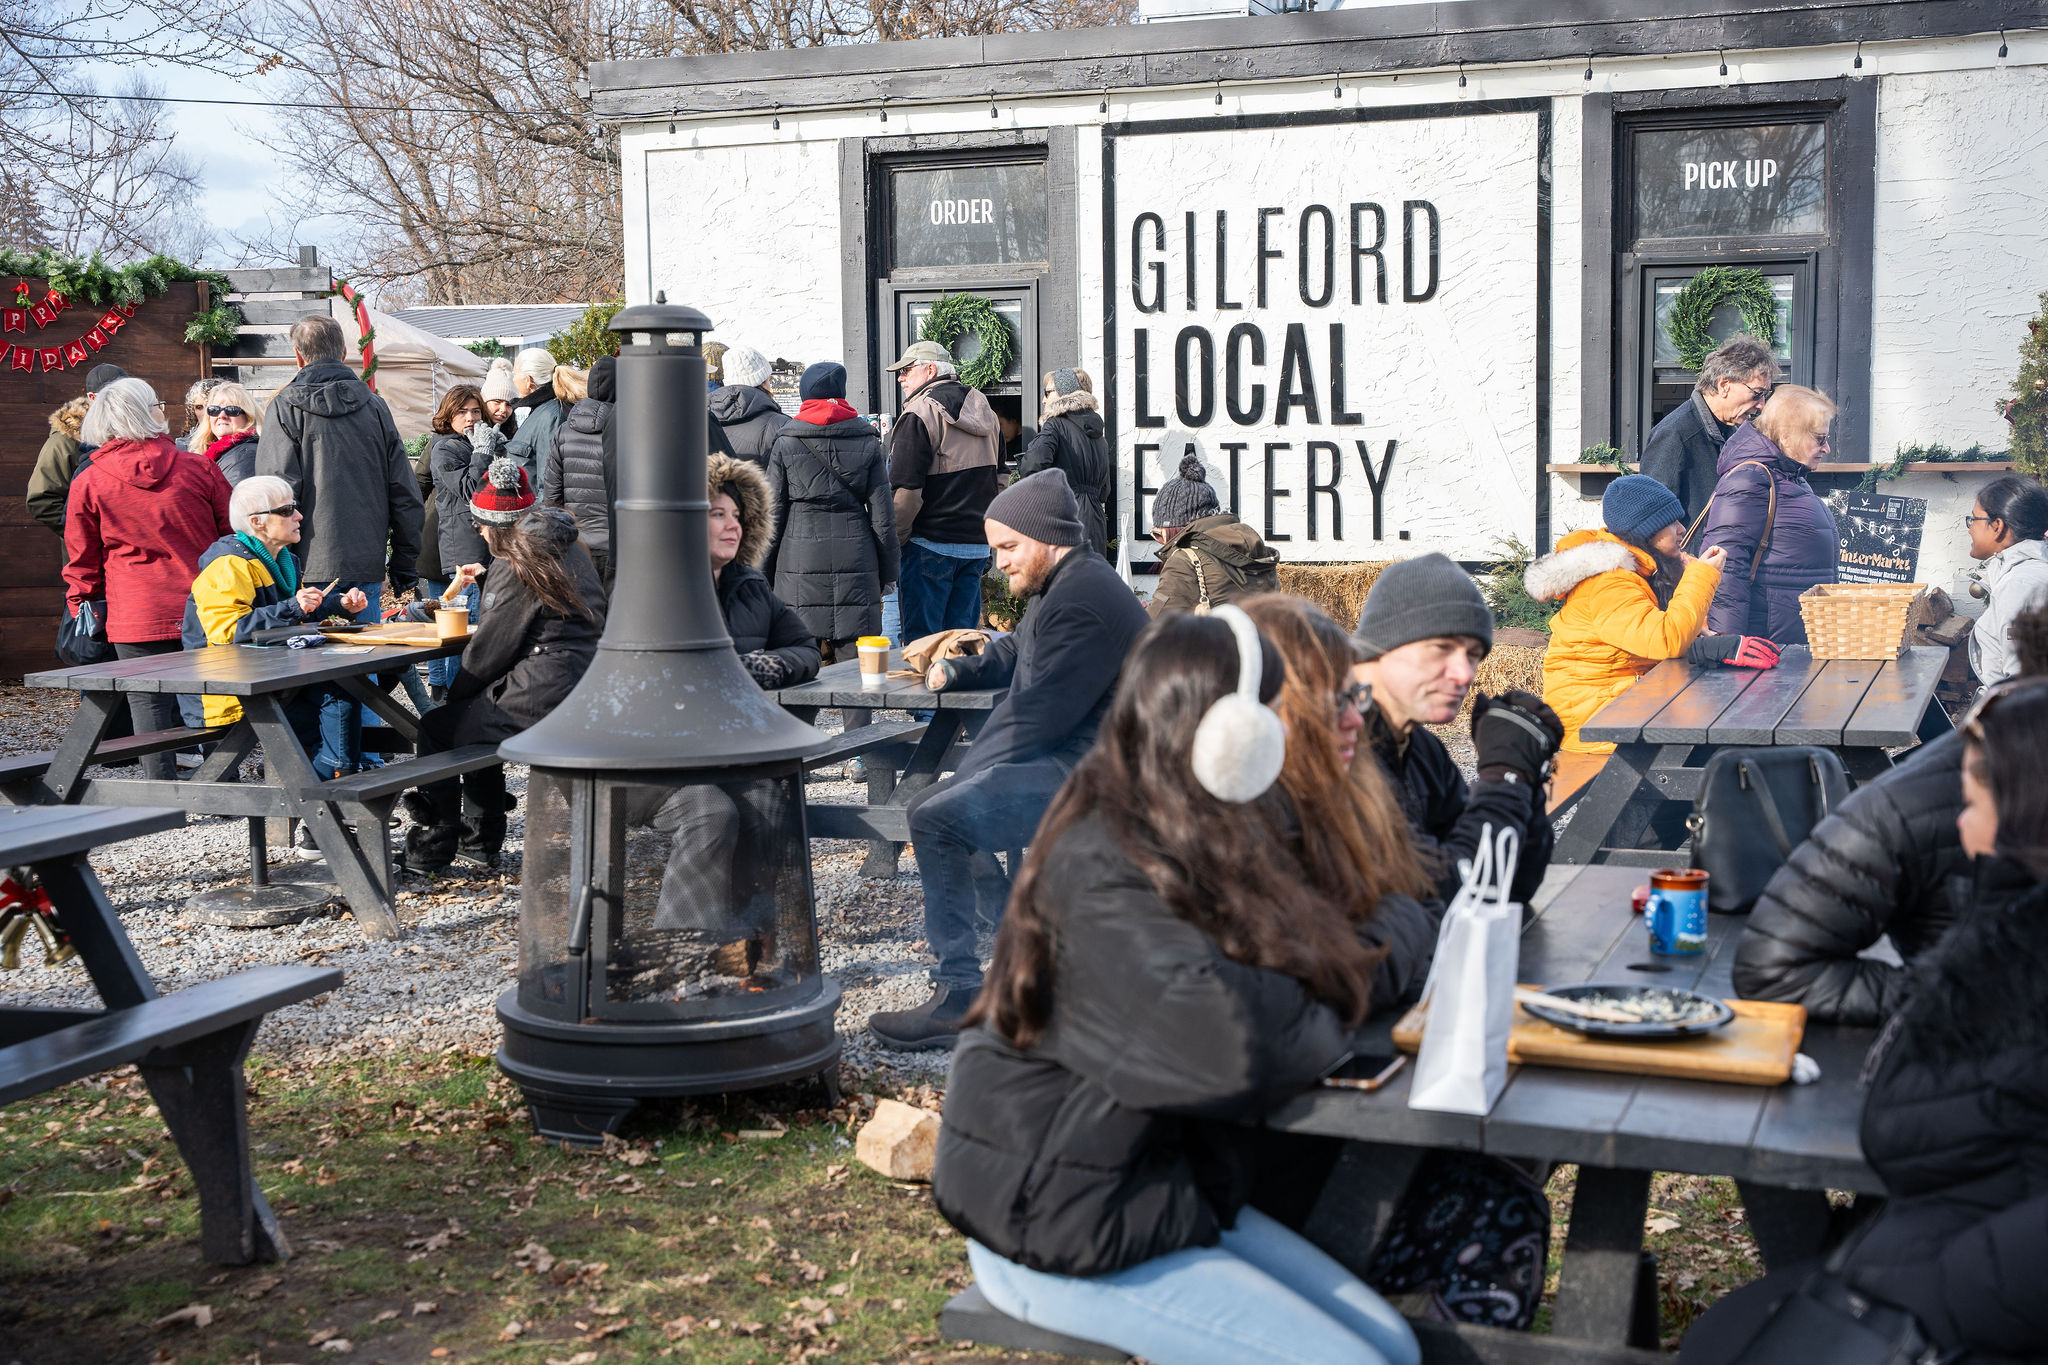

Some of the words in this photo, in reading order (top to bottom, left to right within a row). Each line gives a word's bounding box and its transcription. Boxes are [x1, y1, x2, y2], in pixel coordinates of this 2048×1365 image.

[1684, 160, 1738, 190] PICK
[1745, 158, 1777, 188] UP
[930, 199, 994, 226] ORDER
[1131, 200, 1440, 313] GILFORD
[0, 316, 117, 365] IDAYS
[1134, 323, 1363, 427] LOCAL
[1134, 440, 1410, 541] ETERY.
[1840, 548, 1911, 571] interMarkt
